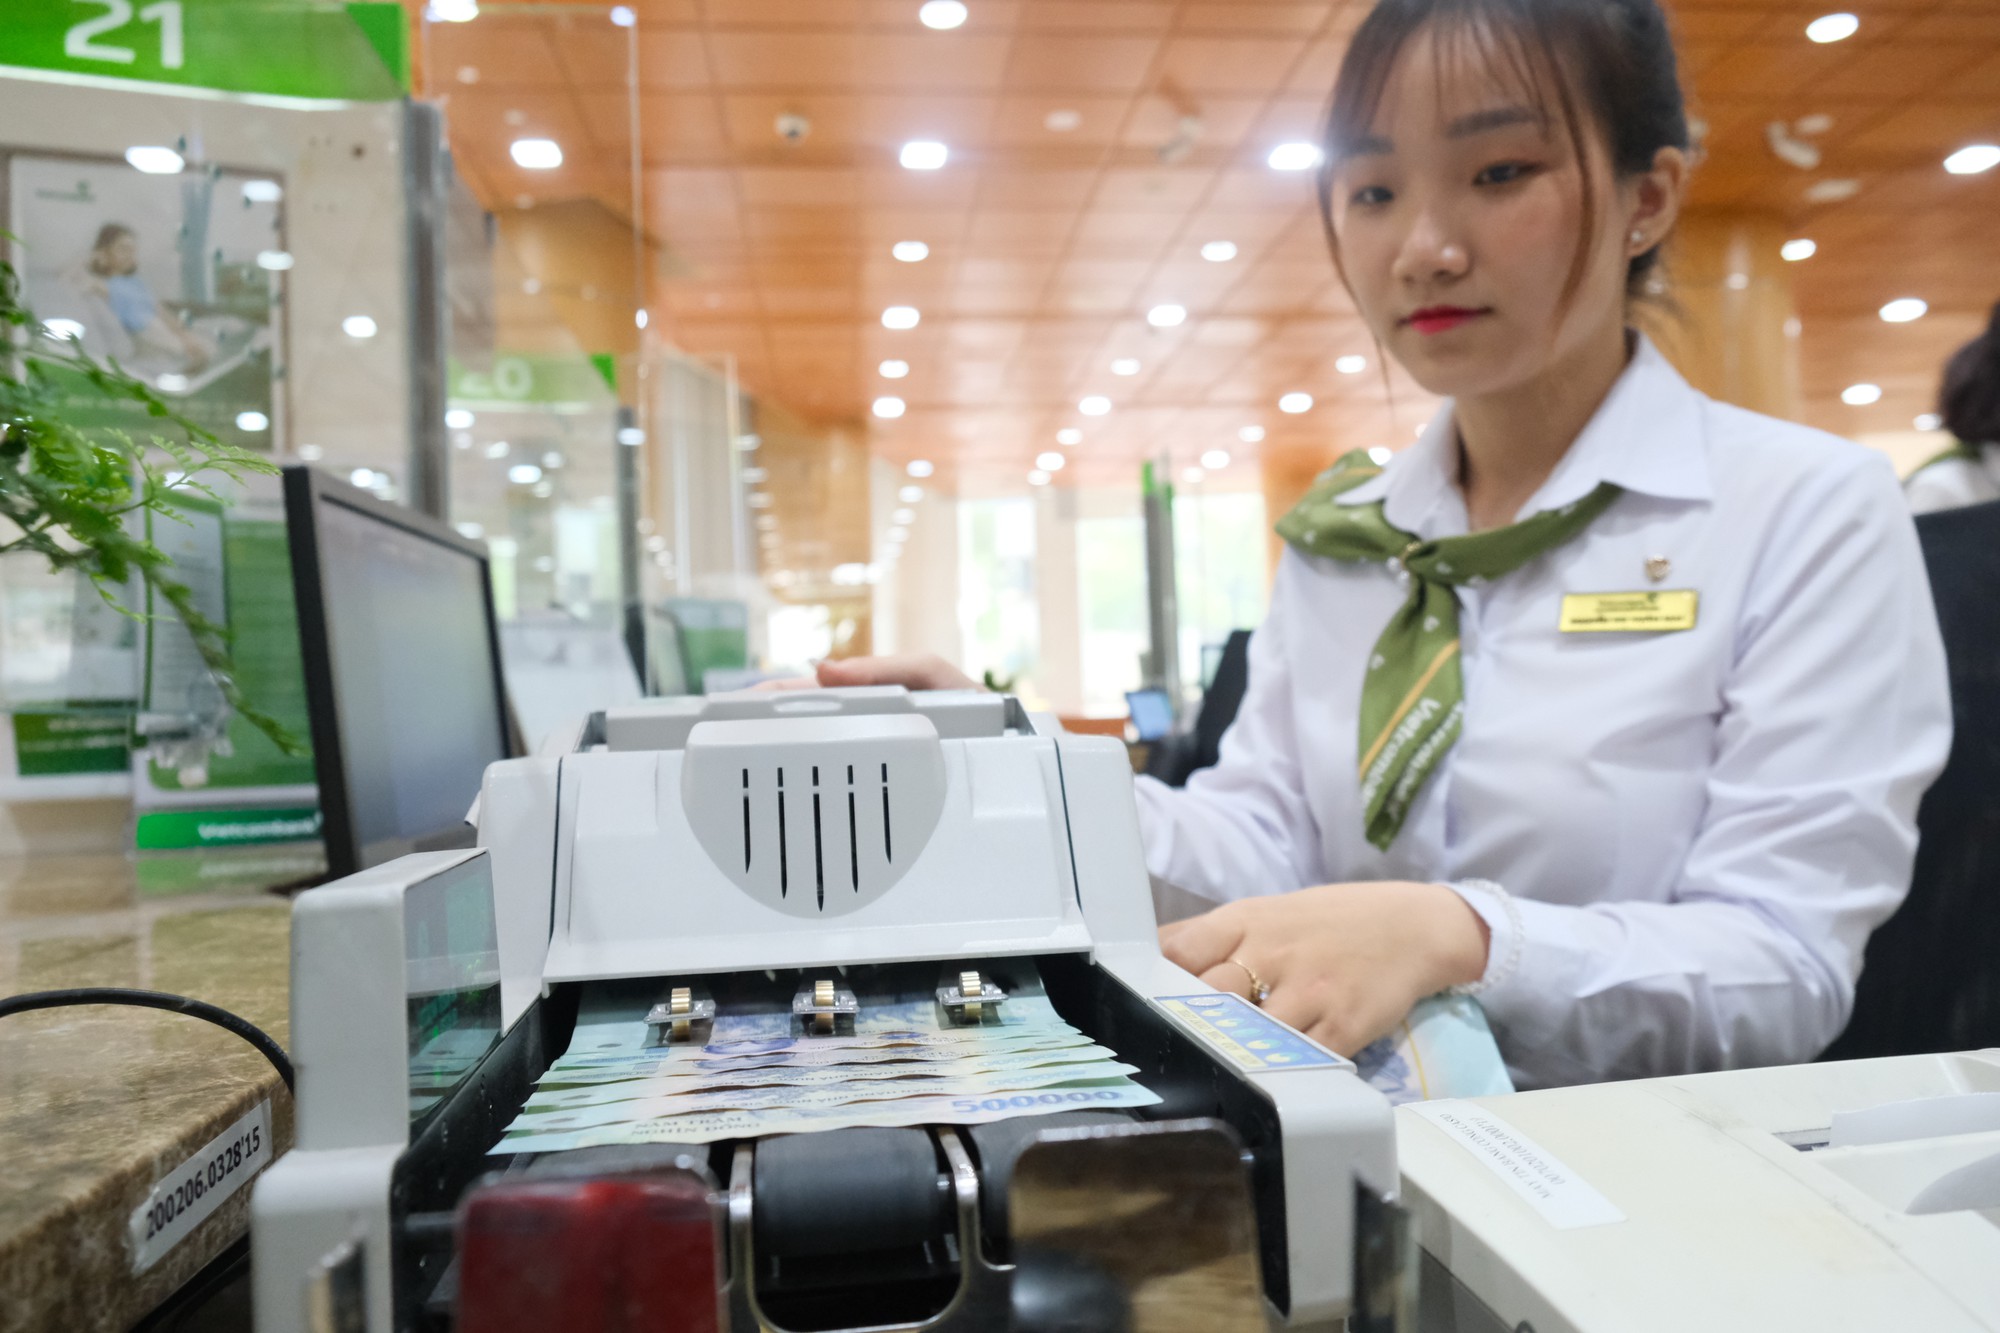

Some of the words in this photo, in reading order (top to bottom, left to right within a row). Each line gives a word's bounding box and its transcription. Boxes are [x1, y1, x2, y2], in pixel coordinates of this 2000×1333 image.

[64, 0, 184, 69] 21
[953, 1091, 1122, 1112] 500000
[146, 1125, 261, 1241] 200206.0328'15
